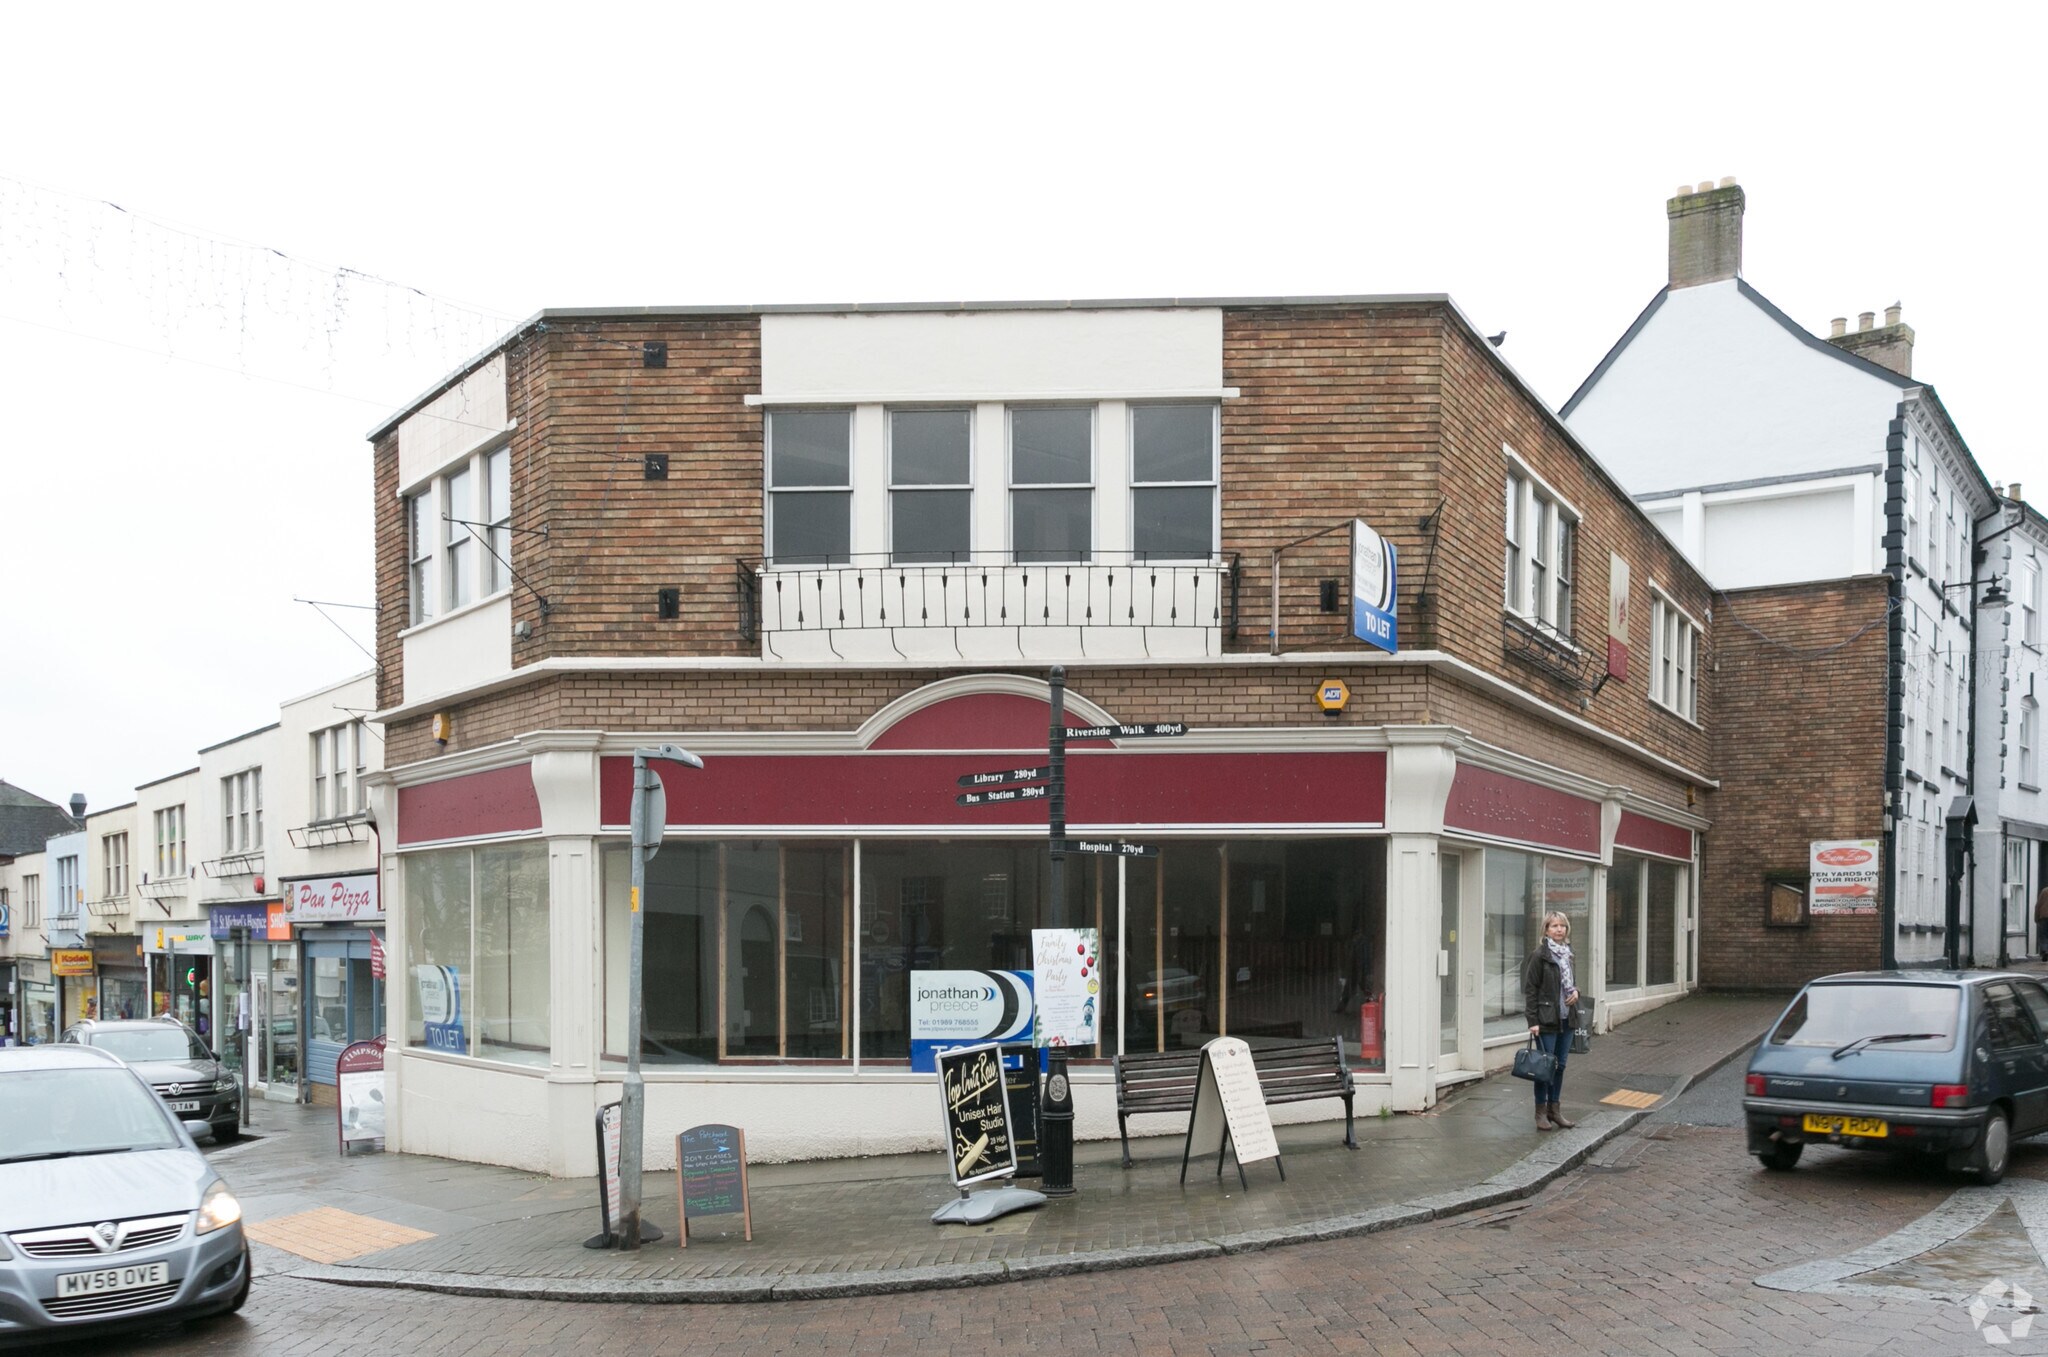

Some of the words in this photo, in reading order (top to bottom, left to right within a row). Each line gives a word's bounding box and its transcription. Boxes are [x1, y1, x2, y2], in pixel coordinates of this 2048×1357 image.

[1365, 611, 1377, 632] TO
[1377, 617, 1391, 640] LET
[1325, 689, 1342, 699] ADT
[1066, 728, 1111, 737] Riverside
[1120, 726, 1145, 735] Walk
[1154, 724, 1182, 735] 400yd
[974, 773, 1004, 783] Library
[1014, 769, 1037, 780] 280yd
[966, 794, 980, 803] Bus
[988, 790, 1015, 800] Station
[1022, 786, 1045, 798] 280yd
[1079, 841, 1112, 853] Hospital
[1121, 844, 1144, 856] 270yd
[299, 884, 325, 910] Pan
[331, 881, 371, 916] Pizza
[248, 913, 267, 933] Hospice
[1041, 937, 1067, 955] Family
[61, 954, 90, 963] Kodak
[1037, 949, 1073, 966] Christmas
[1045, 968, 1068, 986] Party
[917, 986, 979, 1001] jonathan
[930, 1001, 979, 1013] preece
[430, 1027, 442, 1046] TO
[443, 1030, 460, 1049] LET
[178, 1102, 194, 1110] TAW
[958, 1108, 985, 1123] Unisex
[986, 1103, 1003, 1116] Hair
[980, 1117, 1004, 1131] Studio
[682, 1135, 695, 1143] The
[997, 1135, 1007, 1144] High
[994, 1144, 1008, 1153] Street
[125, 1265, 160, 1286] OVE
